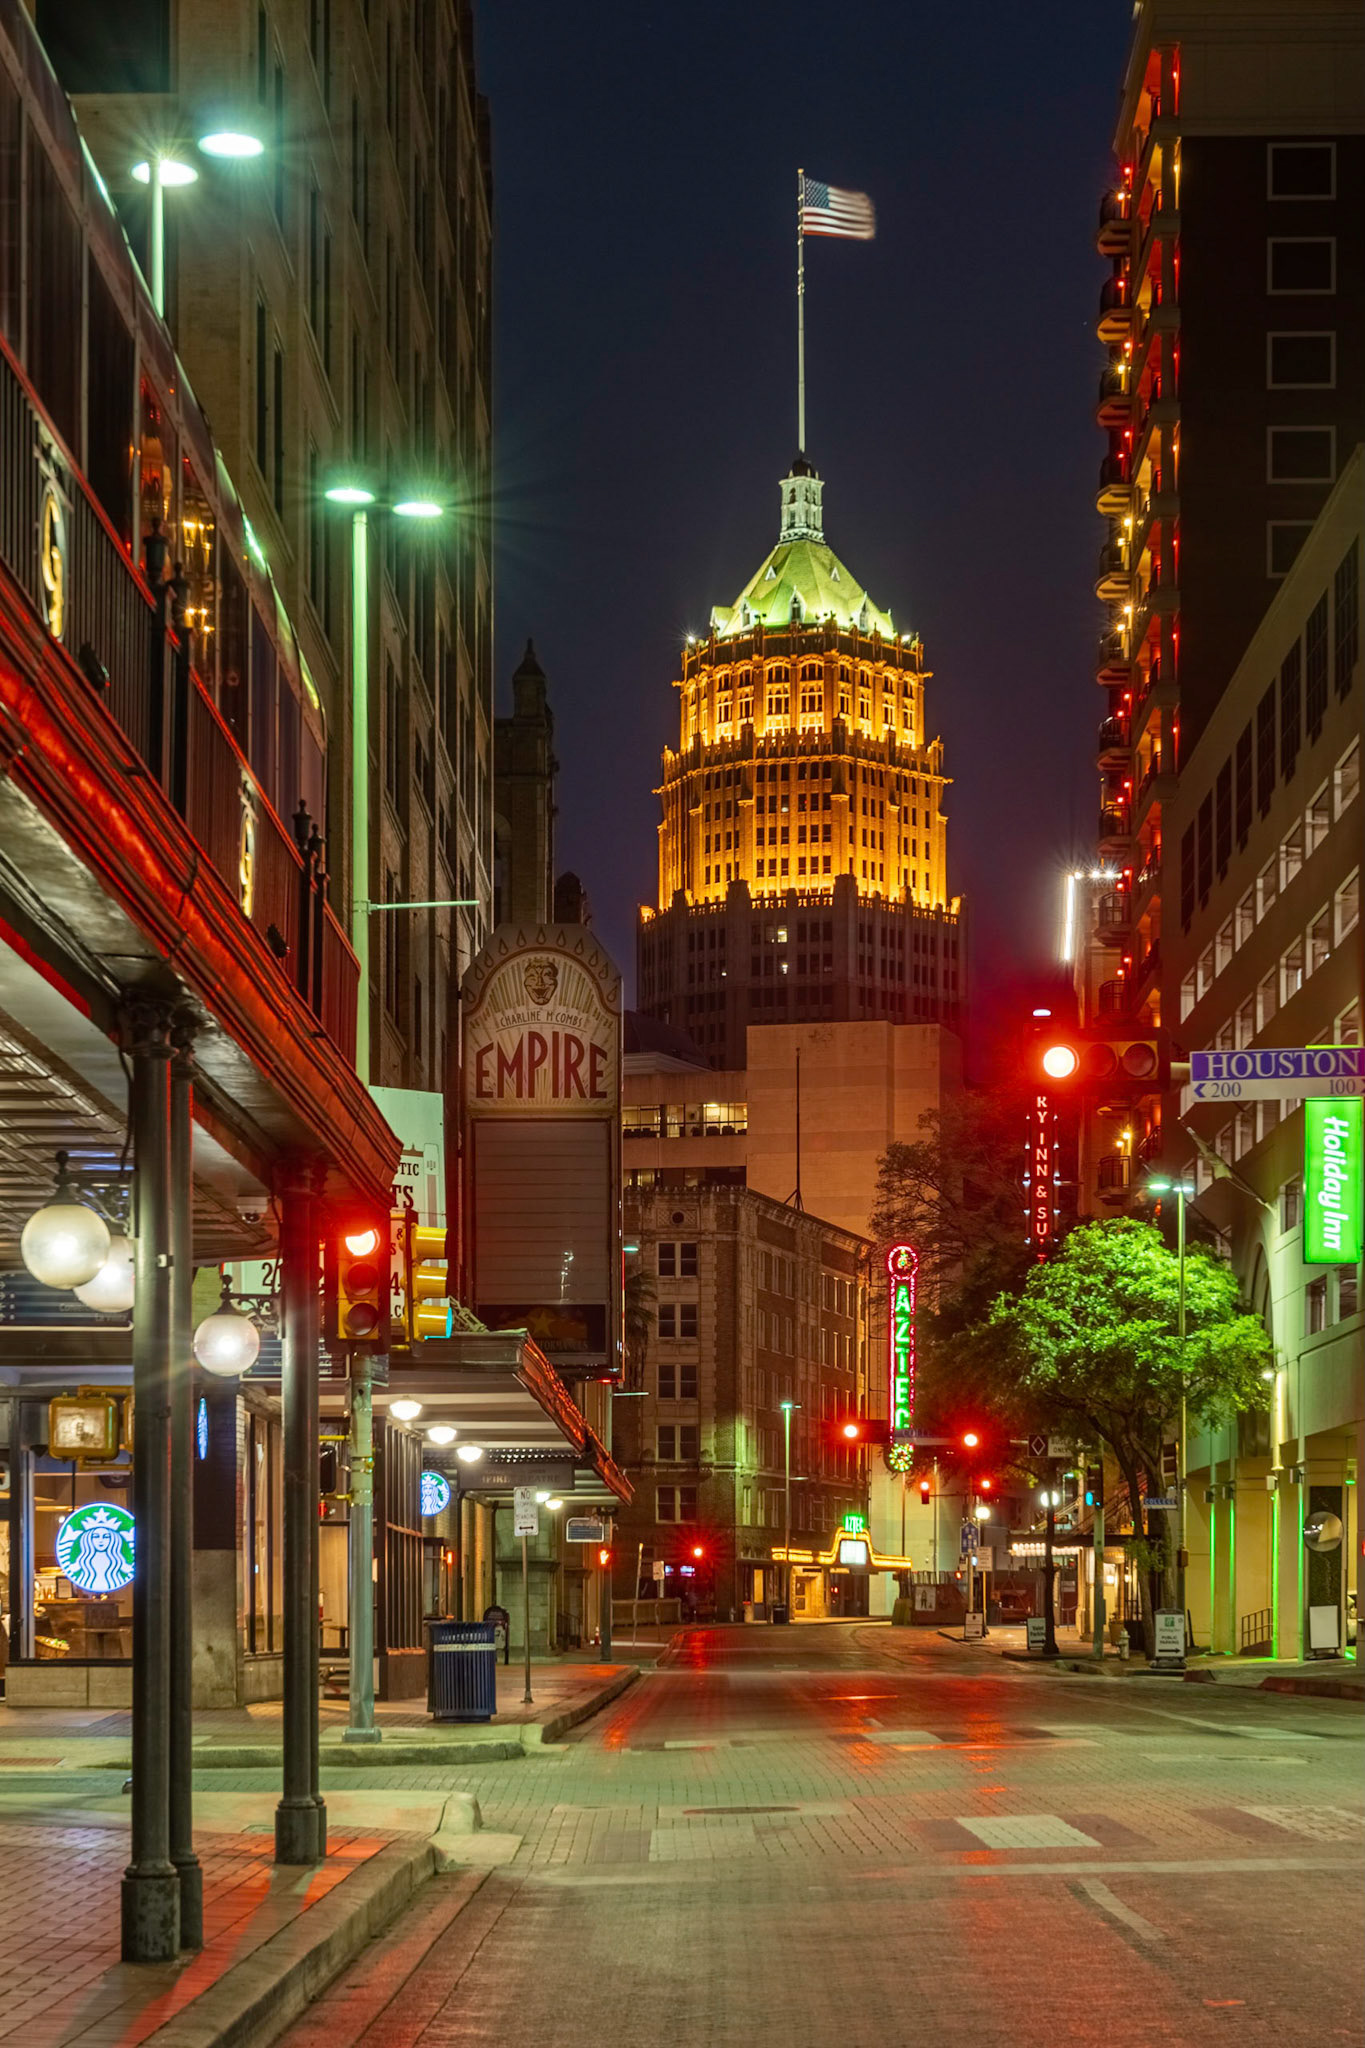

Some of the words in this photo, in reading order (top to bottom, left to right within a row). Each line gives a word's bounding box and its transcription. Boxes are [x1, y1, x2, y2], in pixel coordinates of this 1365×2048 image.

[500, 1010, 541, 1028] CHARLINE
[476, 1030, 608, 1098] EMPIRE
[1205, 1050, 1361, 1079] HOUSTON
[1210, 1082, 1242, 1098] 200
[1329, 1078, 1356, 1094] 100
[1036, 1132, 1048, 1177] INN
[1317, 1115, 1350, 1209] Holiday
[1035, 1185, 1048, 1199] &
[1322, 1210, 1350, 1251] Inn
[894, 1285, 911, 1430] AZTEC
